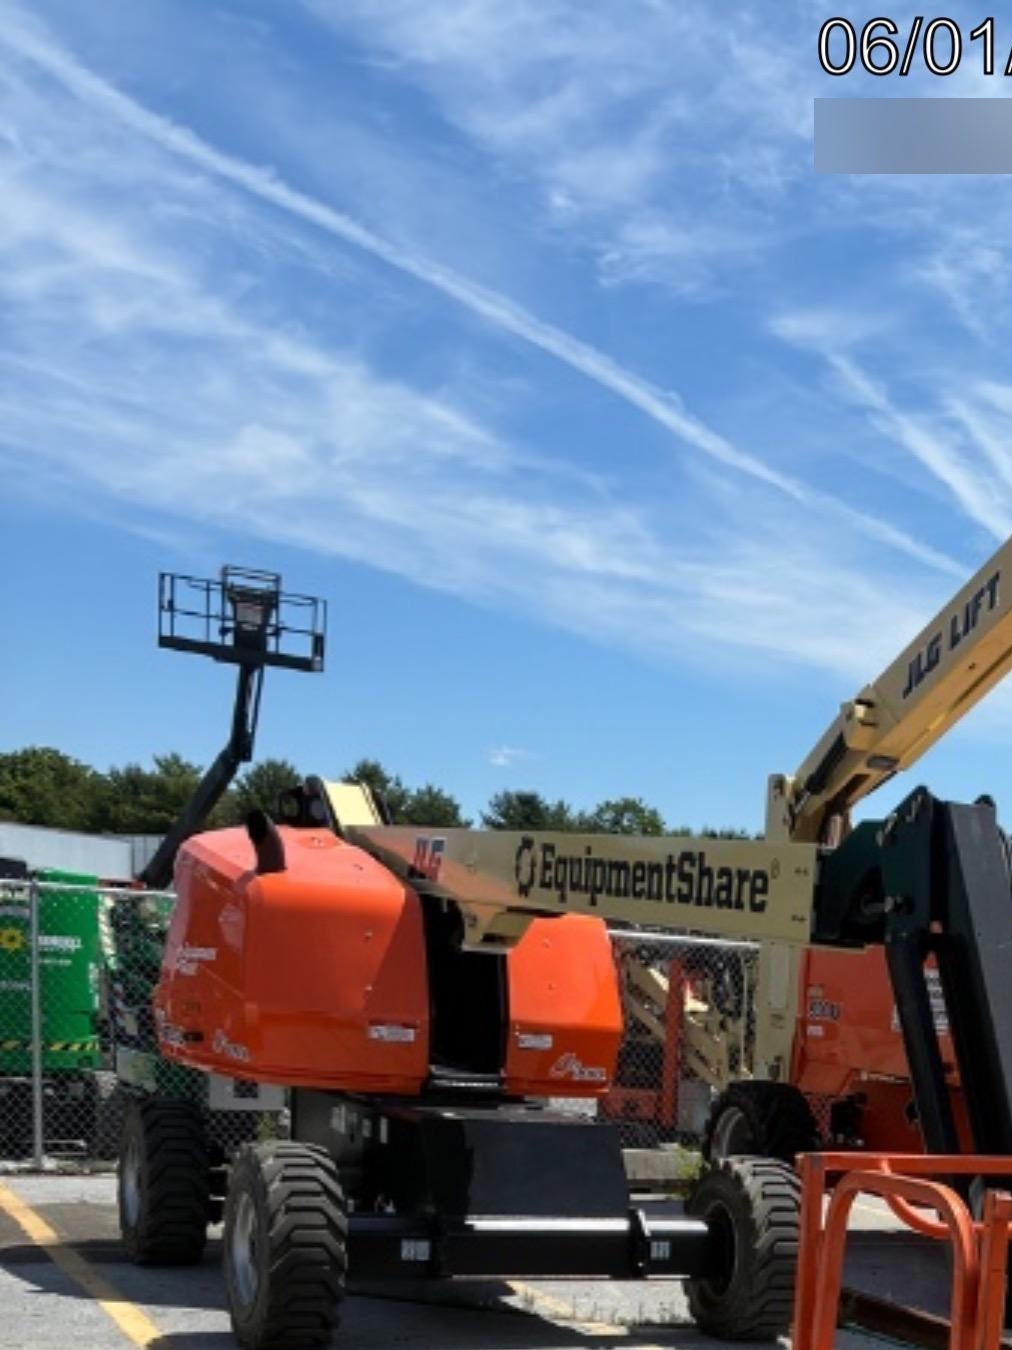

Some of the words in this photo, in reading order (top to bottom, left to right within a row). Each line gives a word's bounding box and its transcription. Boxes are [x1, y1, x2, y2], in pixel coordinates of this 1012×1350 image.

[903, 631, 942, 699] JLG
[950, 570, 1000, 650] LIFT
[539, 842, 769, 913] EquipmentShare
